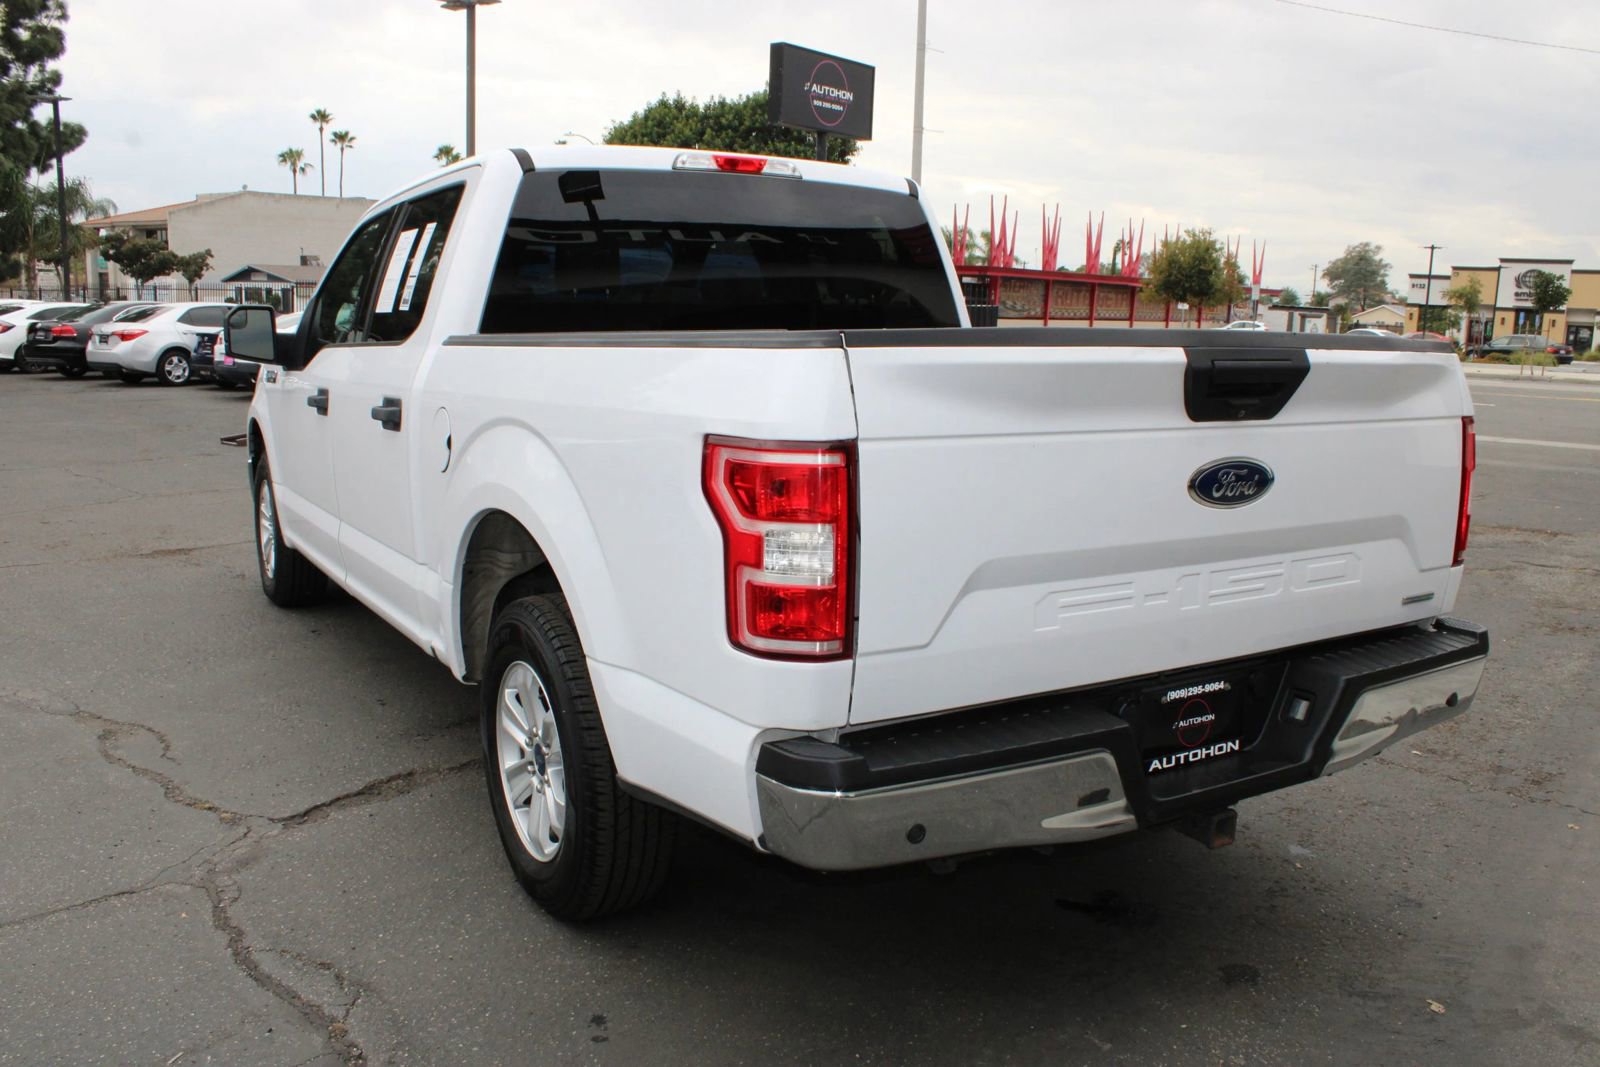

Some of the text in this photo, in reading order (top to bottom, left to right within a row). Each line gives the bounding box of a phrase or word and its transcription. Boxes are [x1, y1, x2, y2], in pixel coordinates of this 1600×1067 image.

[811, 83, 853, 101] AUTOHON
[1212, 468, 1259, 498] Ford
[1034, 551, 1361, 632] F-150
[1167, 681, 1225, 701] (909)295-9064
[1178, 714, 1215, 727] AUTOHON
[1148, 740, 1239, 772] AUTOHON
